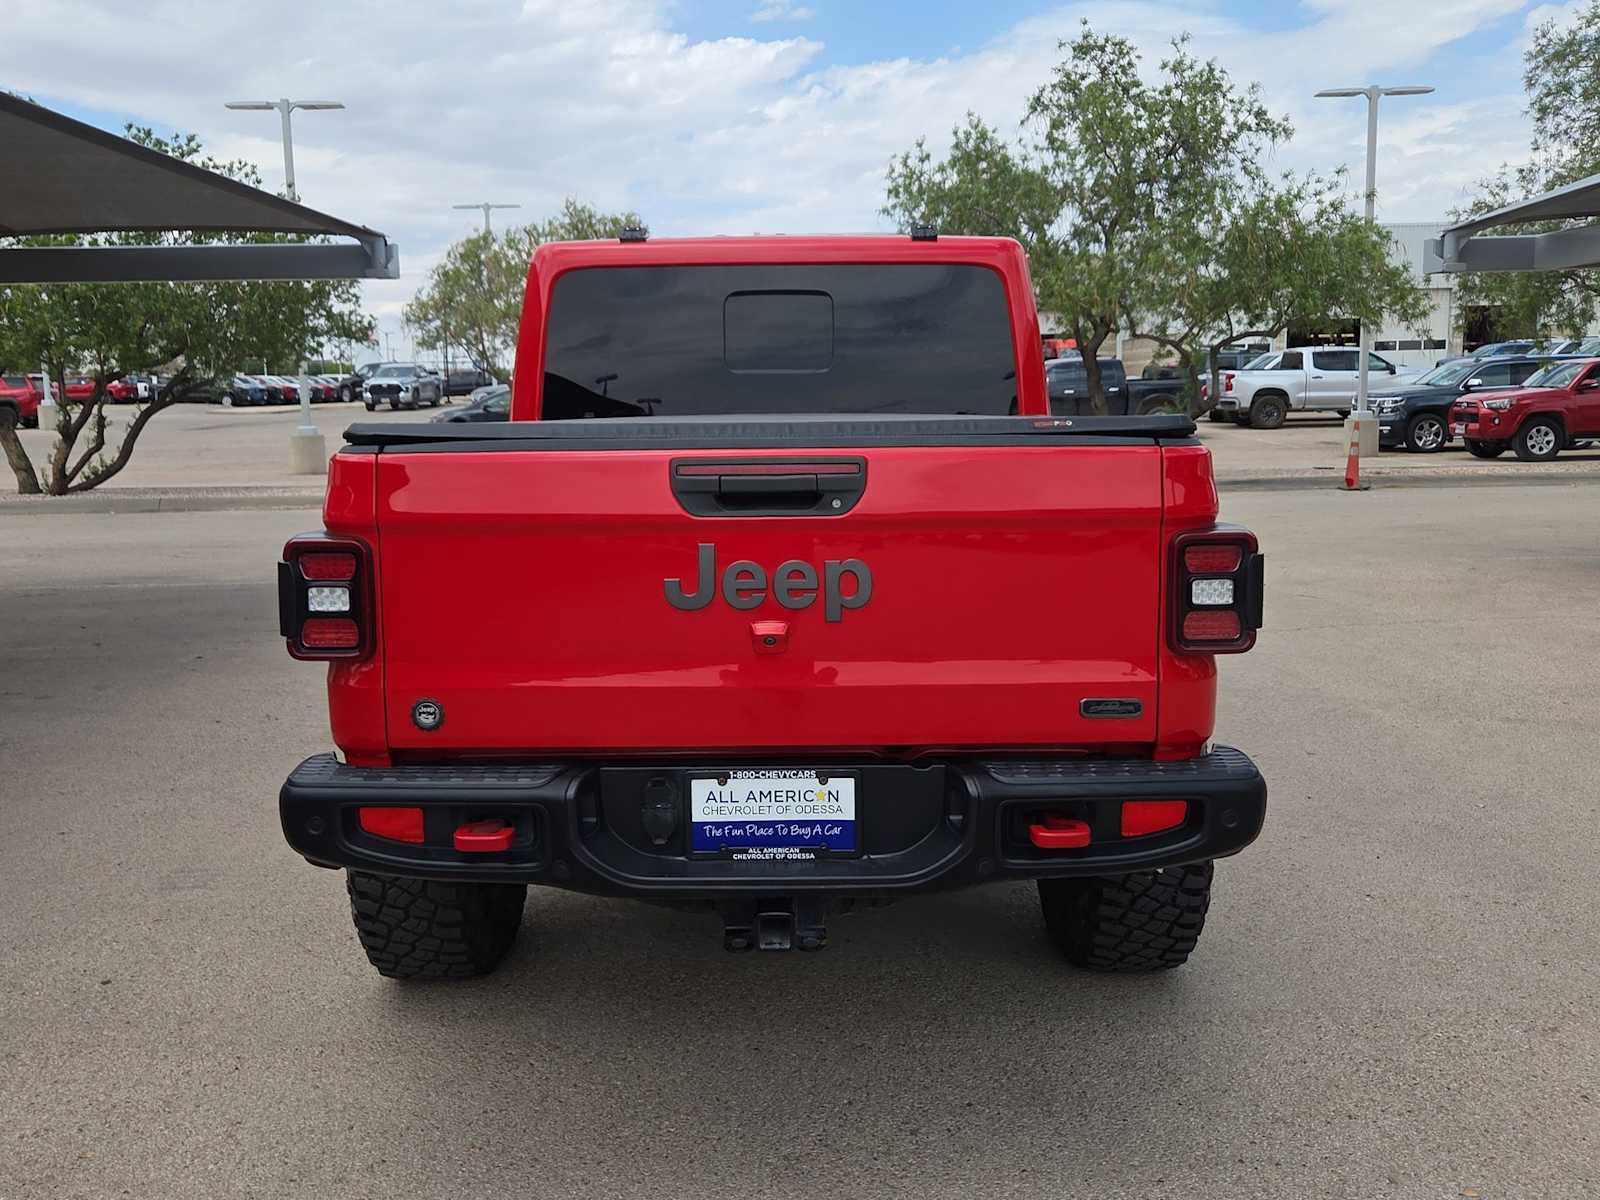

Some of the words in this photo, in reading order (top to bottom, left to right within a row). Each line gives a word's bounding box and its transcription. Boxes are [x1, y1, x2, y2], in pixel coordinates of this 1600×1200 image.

[663, 543, 873, 623] Jeep
[729, 770, 817, 779] 1-800-CHEVYCARS
[705, 790, 739, 803] ALL
[745, 790, 840, 803] AMERICN
[702, 805, 772, 816] CHEVROLET
[775, 805, 793, 814] OF
[795, 804, 843, 814] ODESSA
[704, 825, 722, 838] The
[724, 825, 744, 836] Fun
[746, 824, 774, 836] Place
[775, 825, 788, 836] To
[790, 824, 811, 839] Buy
[812, 824, 822, 835] A
[824, 824, 843, 835] Car
